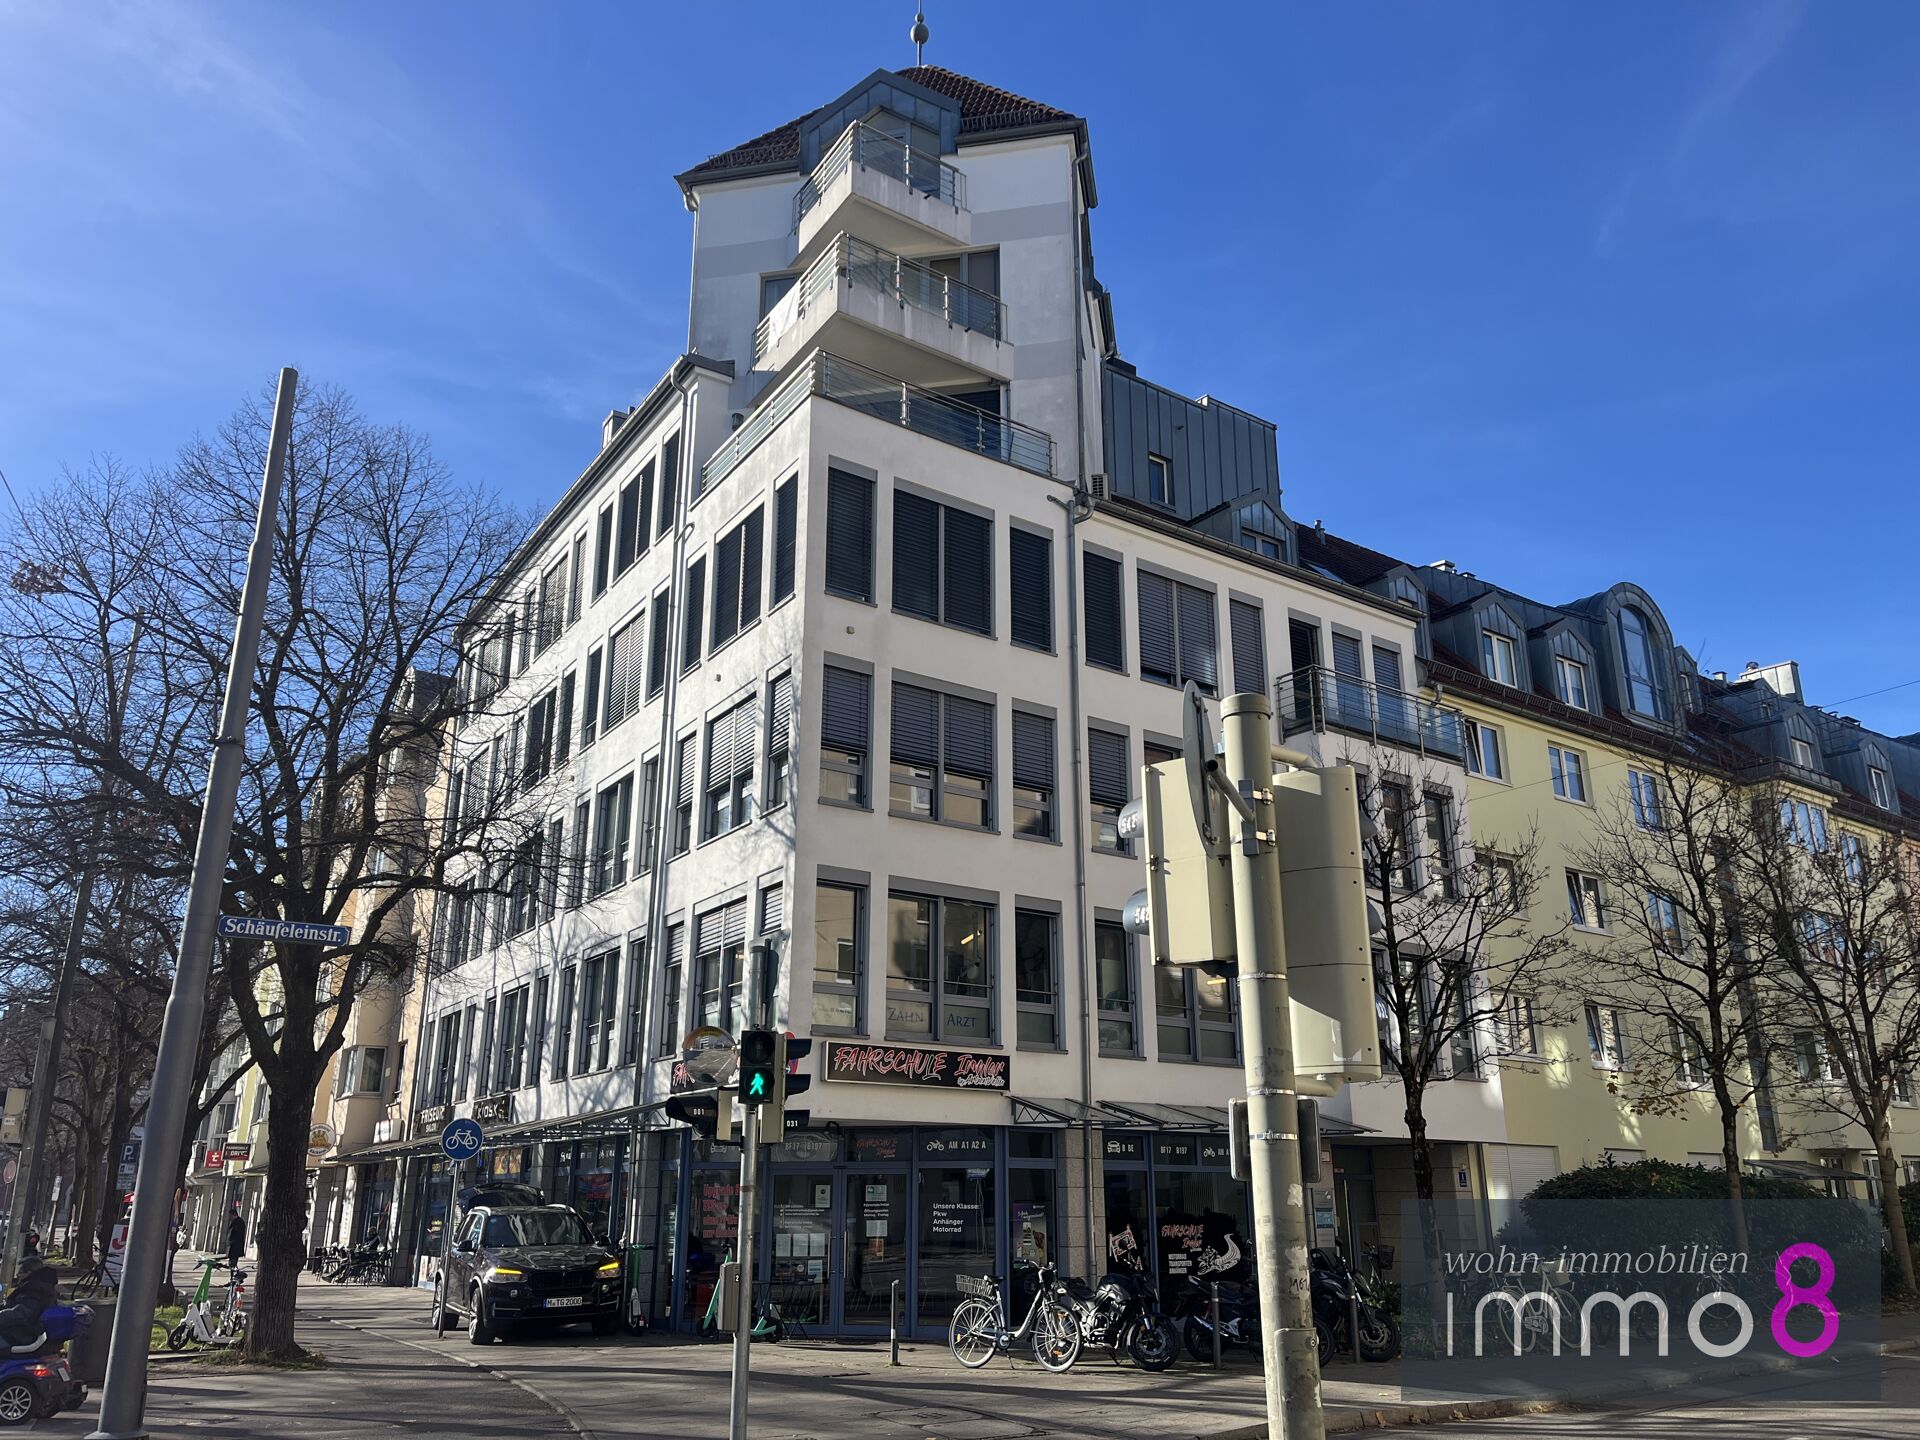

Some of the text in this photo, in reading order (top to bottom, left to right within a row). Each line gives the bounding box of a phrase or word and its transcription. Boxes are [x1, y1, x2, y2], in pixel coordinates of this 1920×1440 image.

[224, 918, 342, 943] Schäufeleinstr.
[834, 1046, 948, 1081] FAHRSCHULE
[948, 1141, 986, 1149] AM A1 A2 A
[933, 1218, 964, 1226] Anhänger
